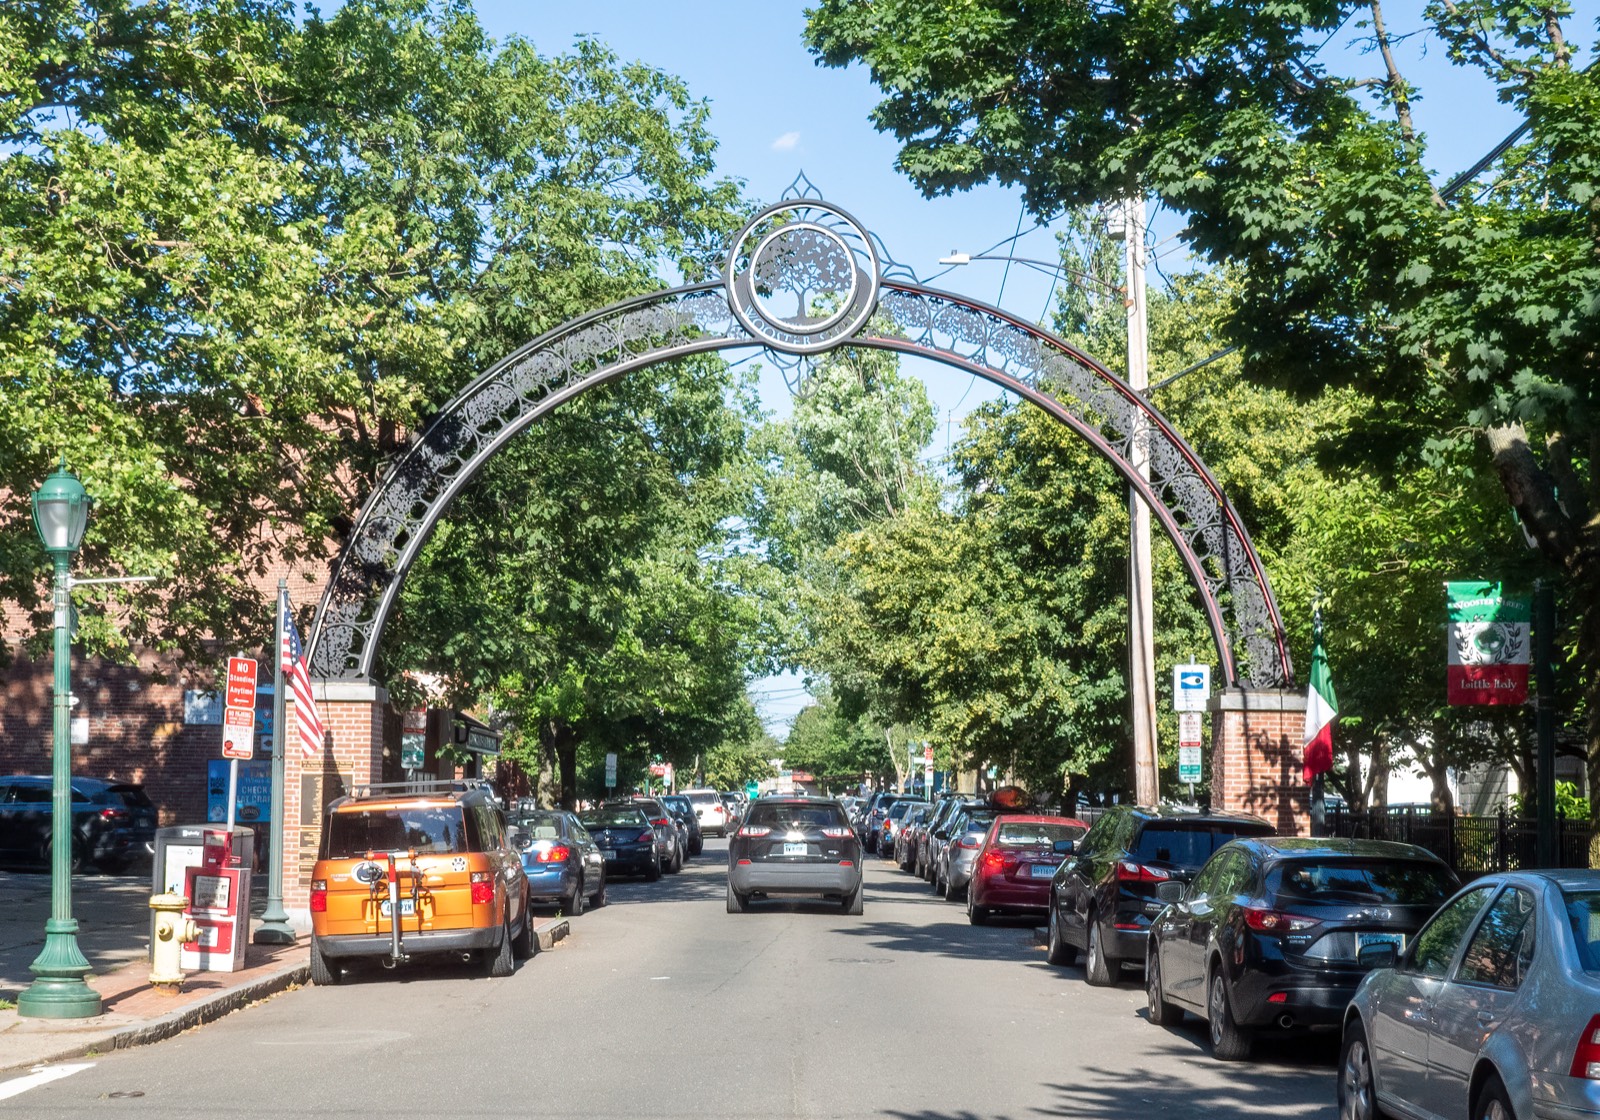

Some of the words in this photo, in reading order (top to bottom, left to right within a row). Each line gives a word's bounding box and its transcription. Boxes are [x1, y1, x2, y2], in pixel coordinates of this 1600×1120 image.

[744, 304, 812, 345] WOOSTER
[1453, 598, 1494, 609] WOOSTER
[1496, 596, 1526, 611] STREET
[237, 662, 249, 673] NO
[230, 673, 255, 686] Standing
[1461, 679, 1491, 690] Little
[1494, 679, 1517, 692] Italy
[230, 686, 253, 696] Anytime
[241, 785, 267, 795] CHECK
